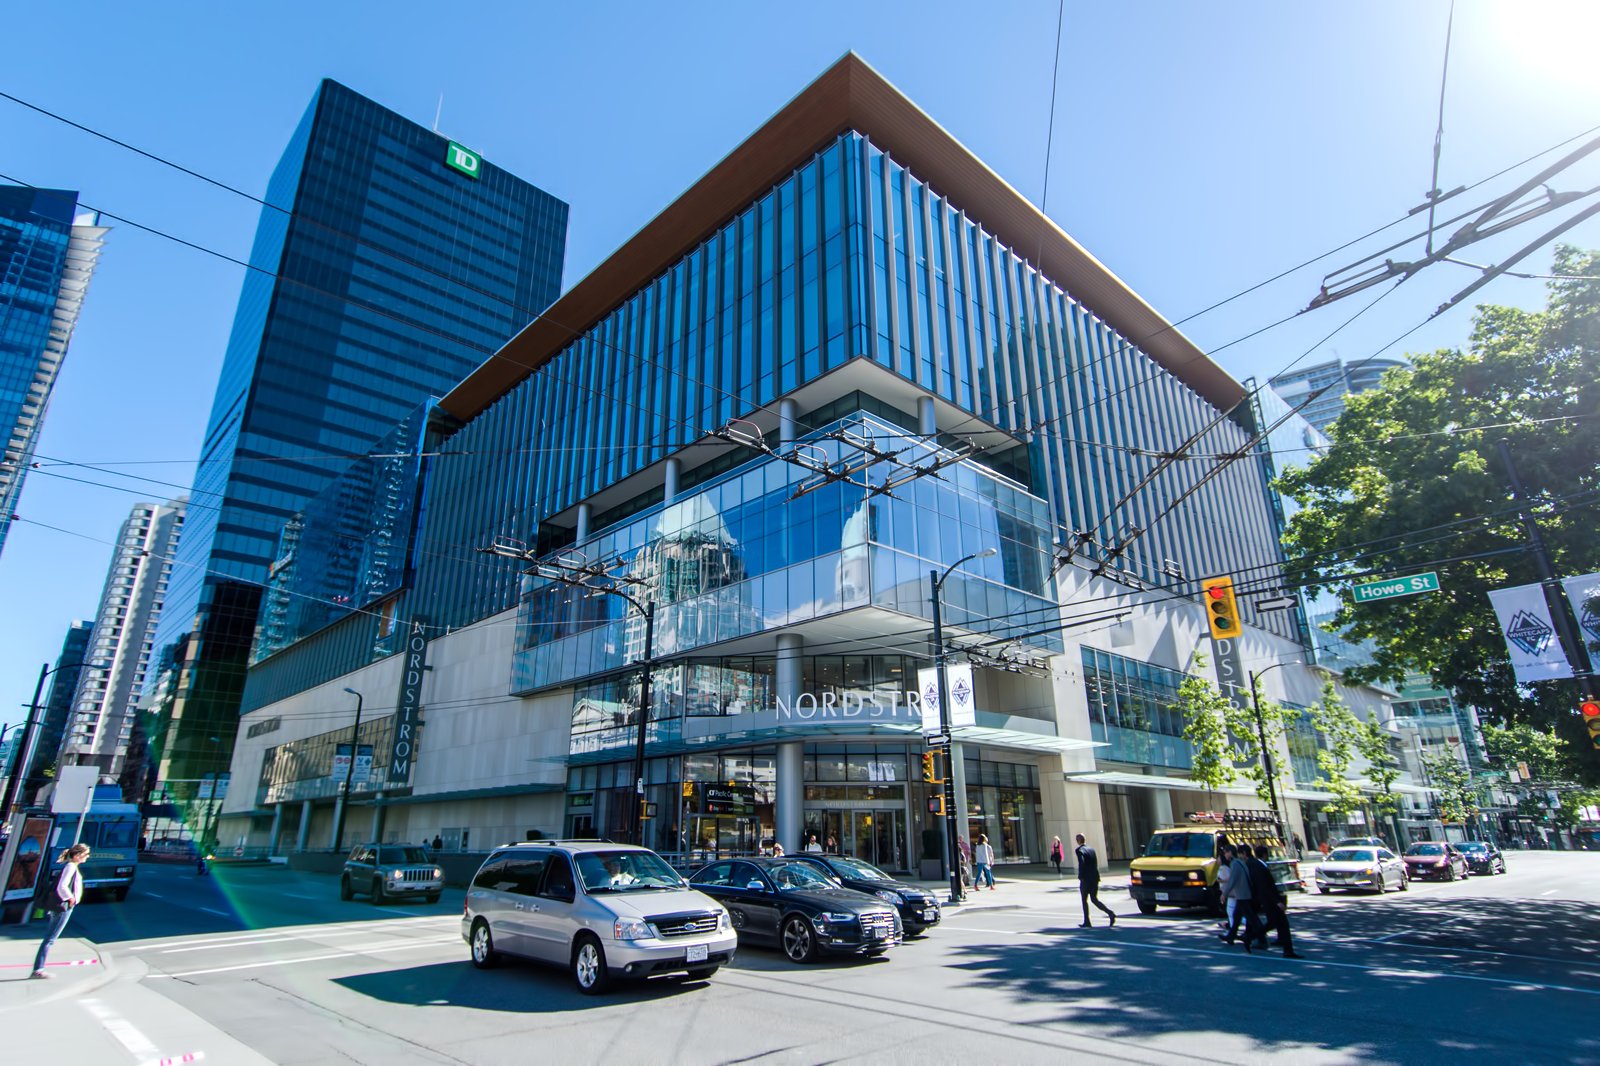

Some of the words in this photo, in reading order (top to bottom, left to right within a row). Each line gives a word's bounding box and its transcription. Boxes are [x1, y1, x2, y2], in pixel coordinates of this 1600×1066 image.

[452, 145, 477, 171] TD
[1361, 584, 1405, 598] Howe
[1411, 577, 1431, 590] St
[1508, 628, 1551, 638] WHITECAPS
[392, 621, 426, 775] NORDSTROM
[775, 690, 922, 720] NORDSTR
